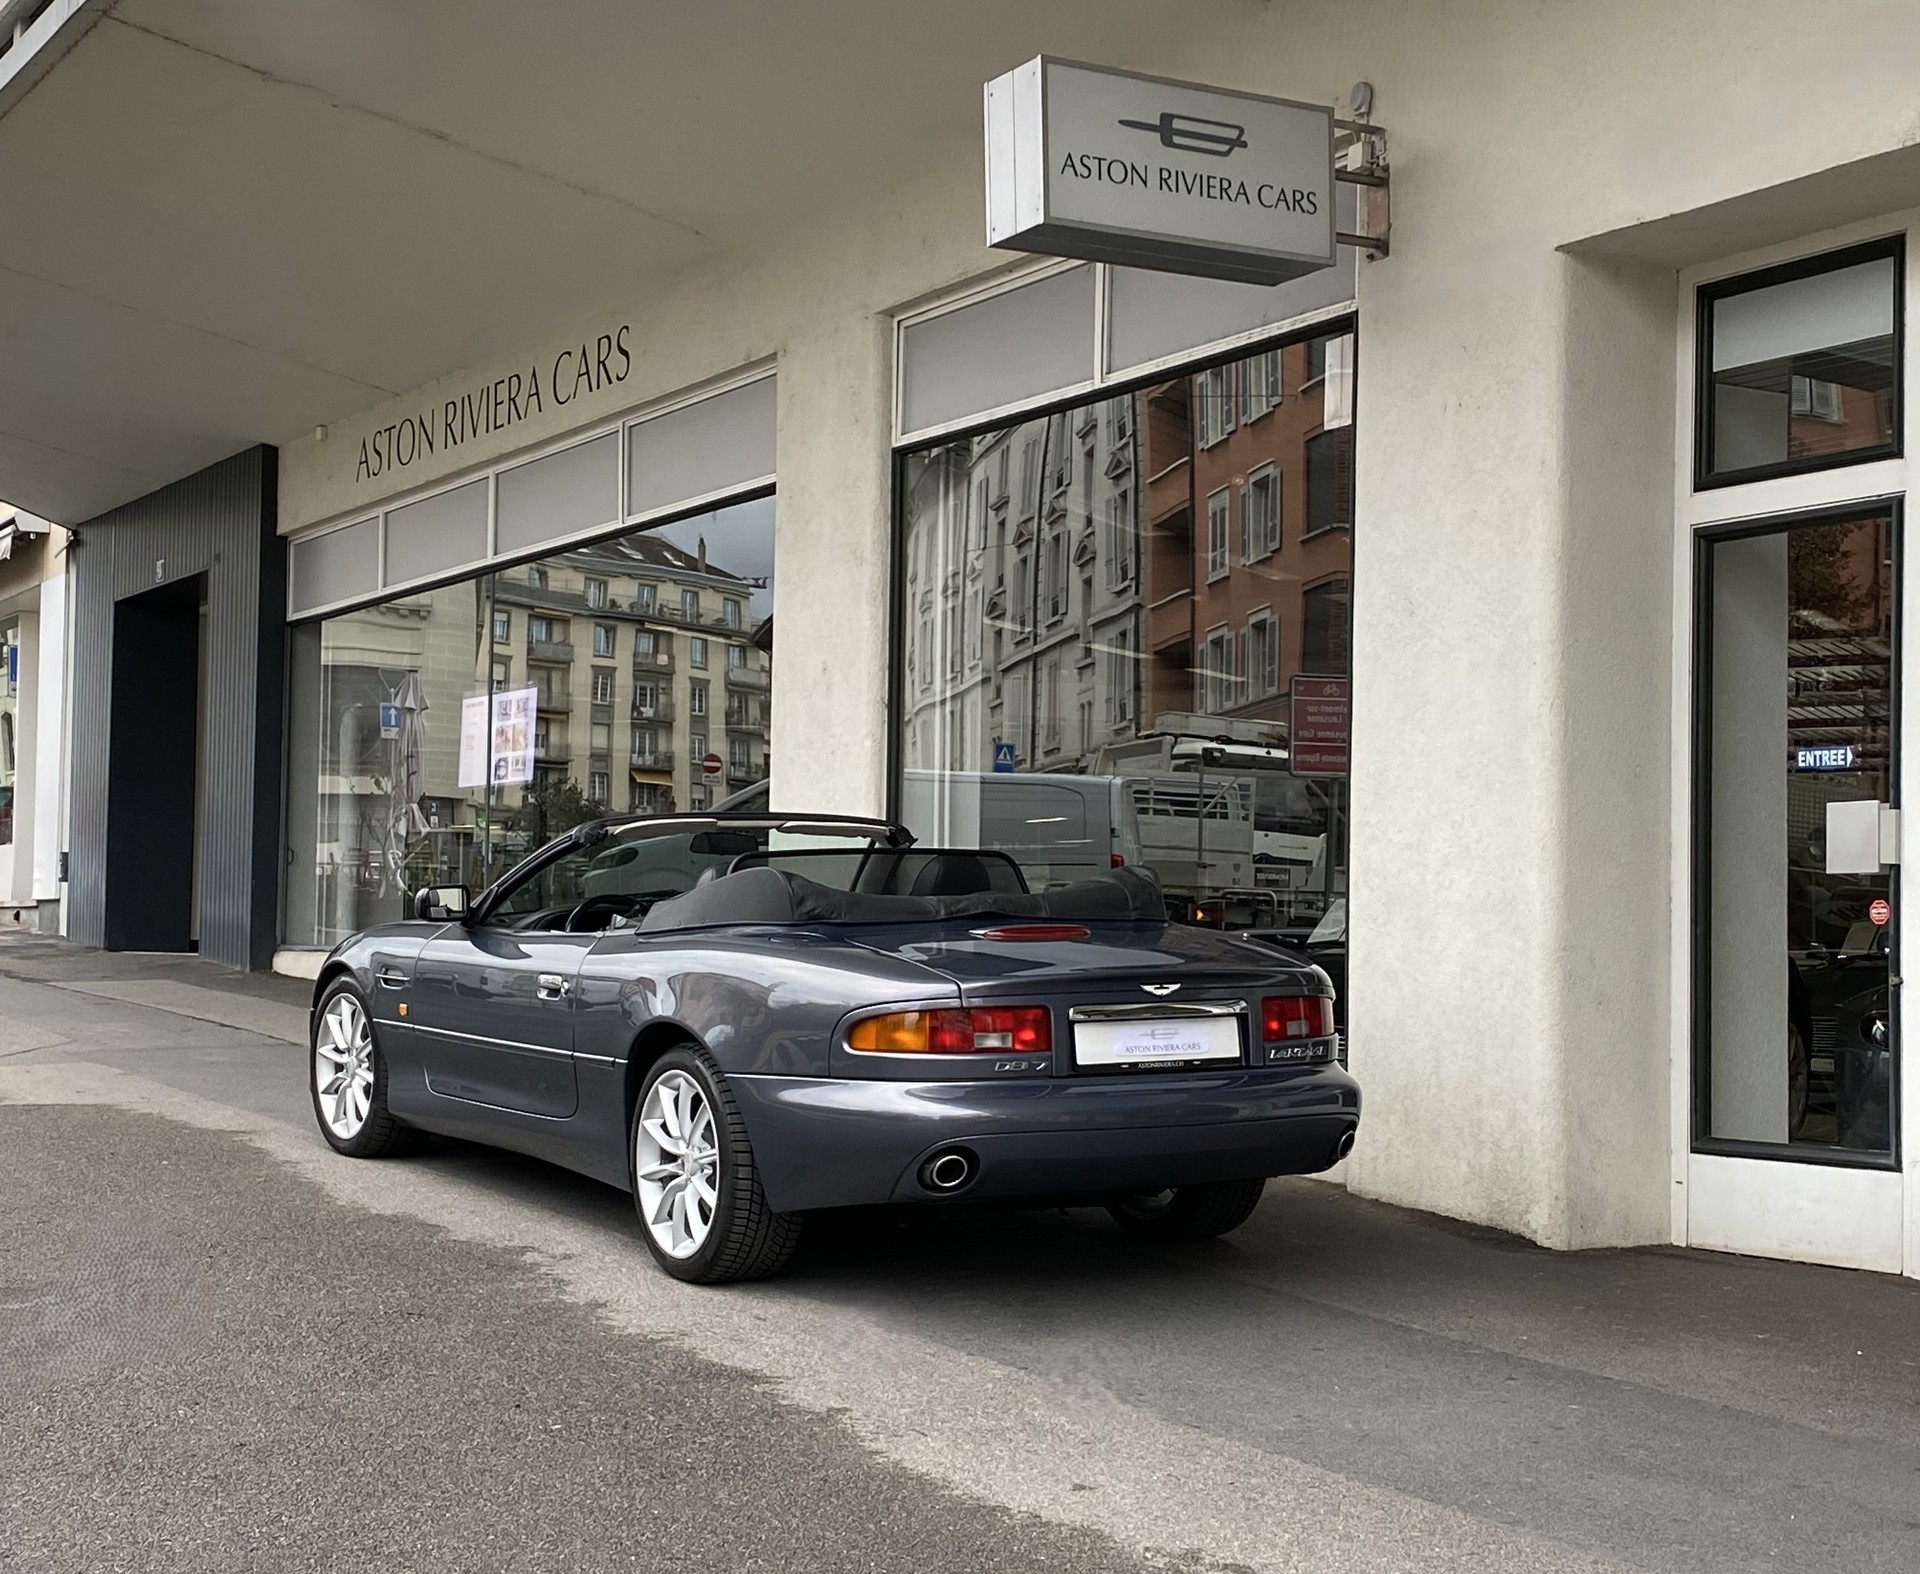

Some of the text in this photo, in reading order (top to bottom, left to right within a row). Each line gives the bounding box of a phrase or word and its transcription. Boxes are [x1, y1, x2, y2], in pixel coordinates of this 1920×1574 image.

[1060, 151, 1318, 215] ASTON RIVIERA CARS
[356, 325, 631, 484] ASTON RIVIERA CARS
[1798, 749, 1846, 767] ENTREE
[1125, 1042, 1202, 1054] ASTON RIVIERA CARS
